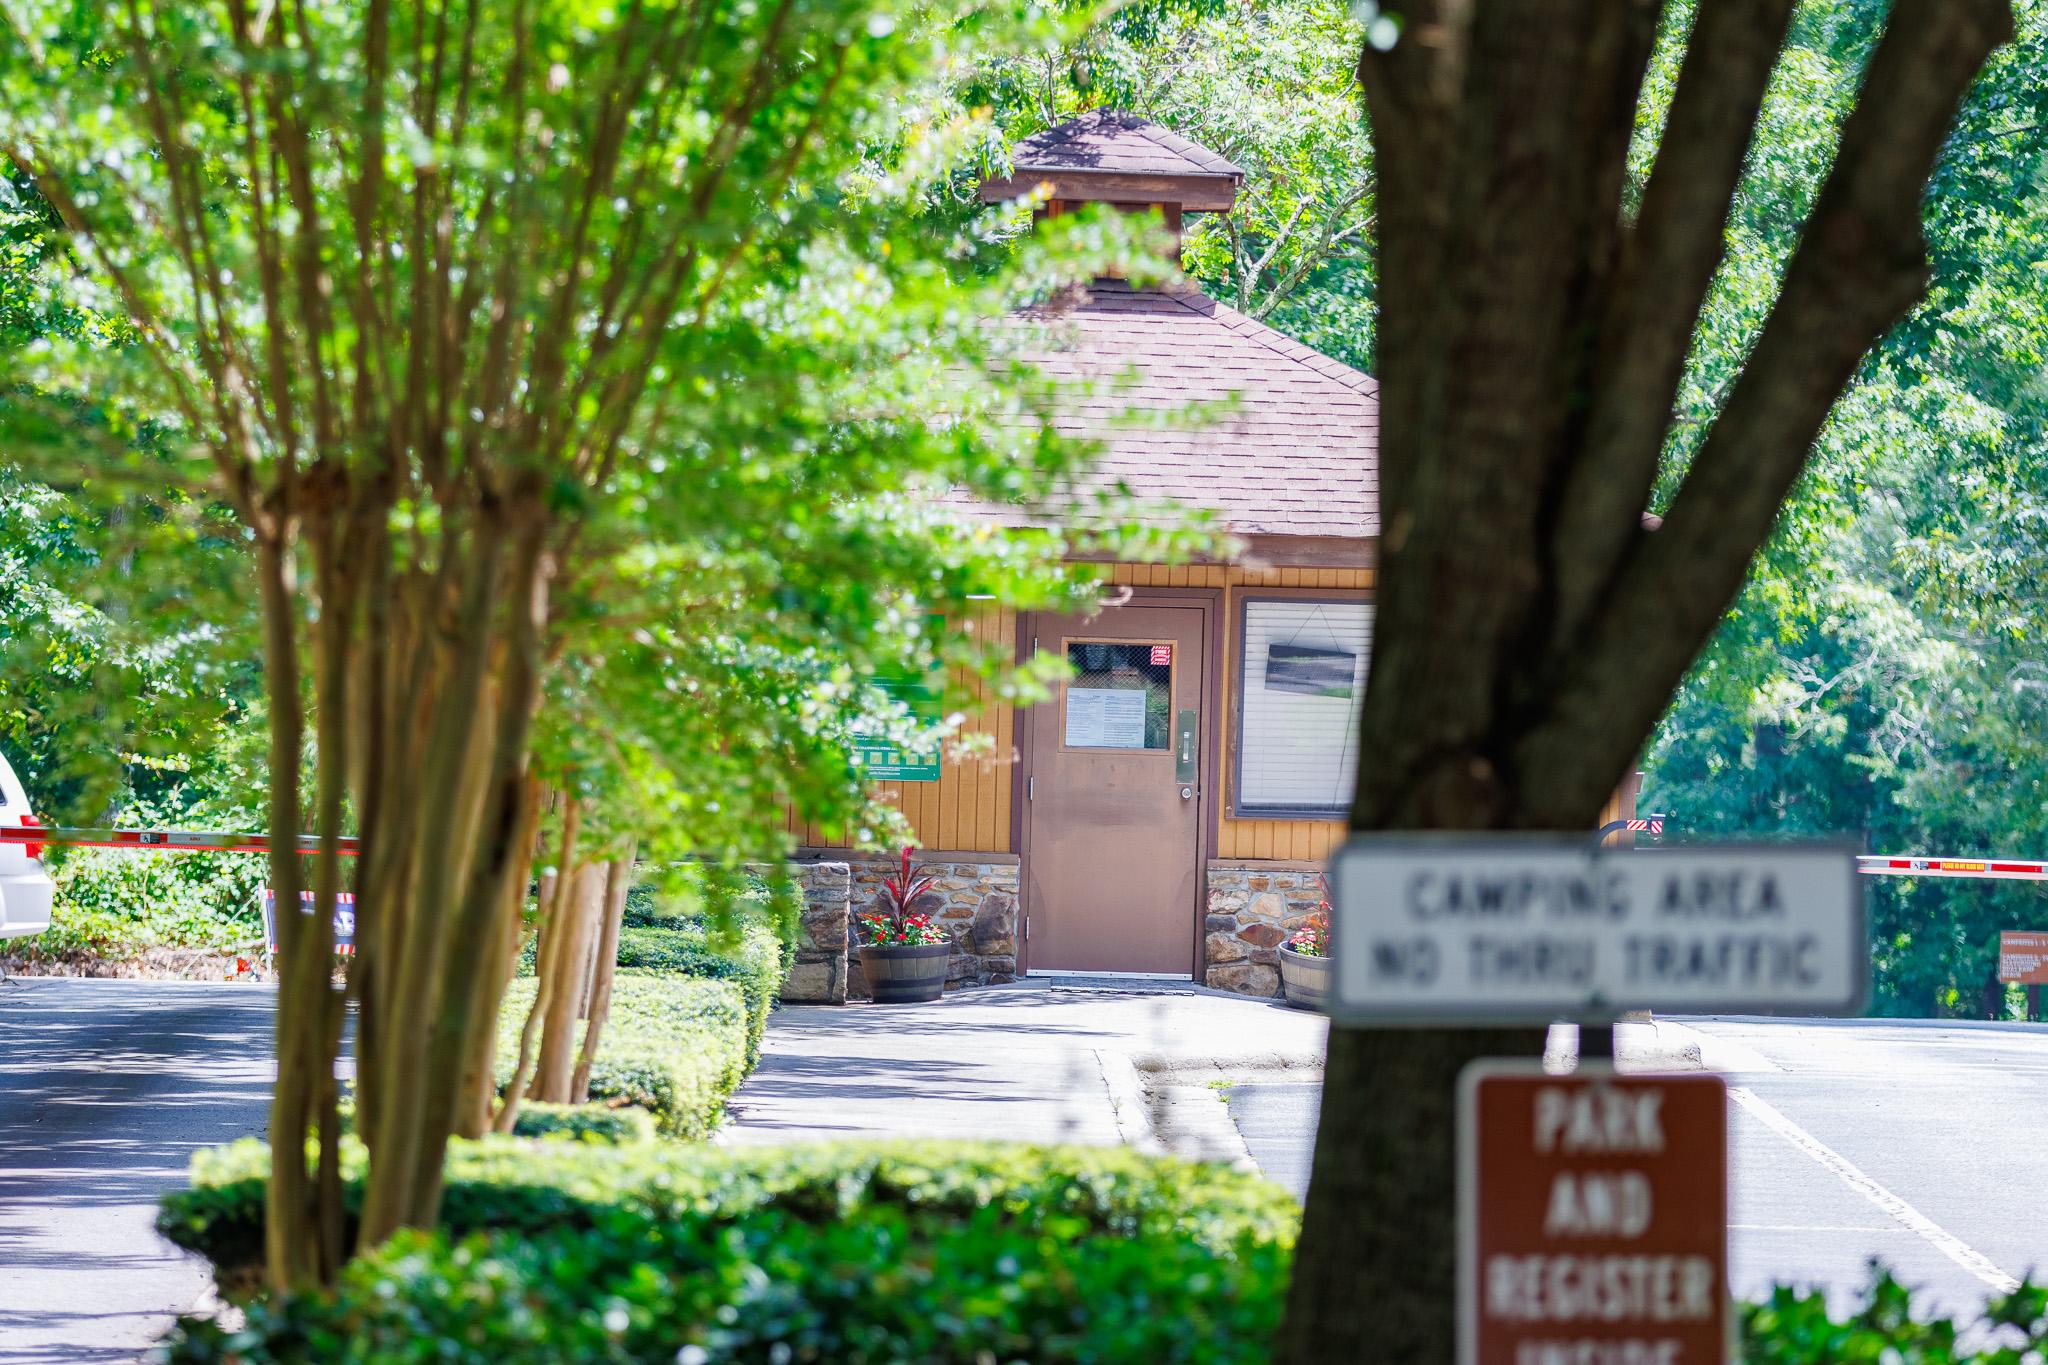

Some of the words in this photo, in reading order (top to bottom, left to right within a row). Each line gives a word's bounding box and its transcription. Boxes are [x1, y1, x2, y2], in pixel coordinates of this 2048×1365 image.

[1408, 871, 1631, 921] CAMPING
[1657, 870, 1787, 920] AREA
[1370, 934, 1442, 986] NO
[1468, 934, 1595, 986] THRU
[1622, 934, 1821, 986] TRAFFIC
[1533, 1086, 1666, 1153] PARK
[1545, 1171, 1653, 1237] AND
[1487, 1254, 1715, 1319] REGISTER
